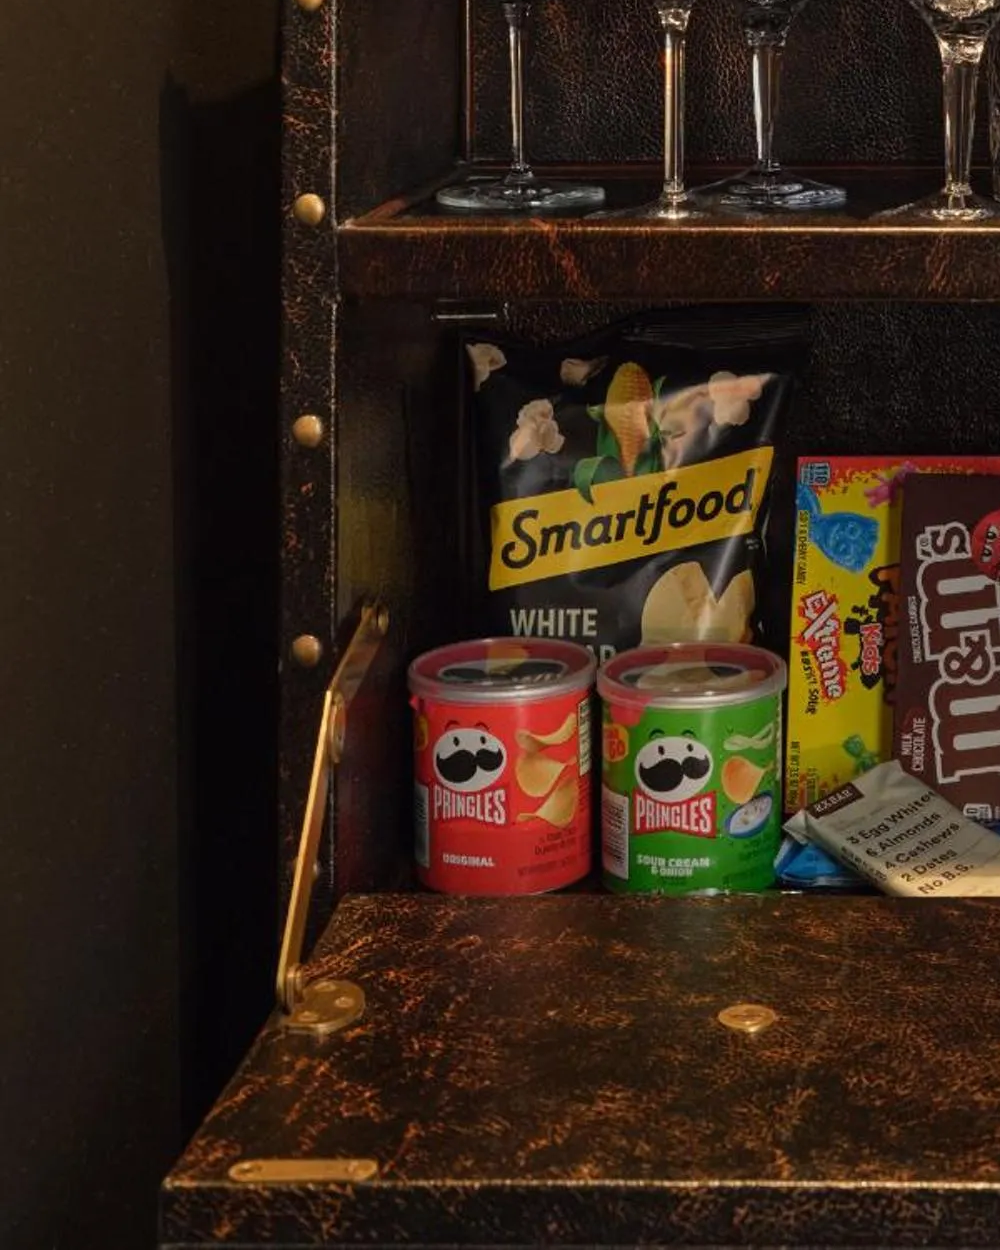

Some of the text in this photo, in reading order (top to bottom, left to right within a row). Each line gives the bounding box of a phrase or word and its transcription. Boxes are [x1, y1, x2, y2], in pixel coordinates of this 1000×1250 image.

[501, 468, 757, 570] Smartfood
[510, 608, 598, 637] WHITE
[805, 688, 819, 716] SOUR
[902, 732, 913, 756] MILK
[912, 717, 926, 772] CHOCOLATE
[433, 784, 506, 825] PRINGLES
[635, 794, 712, 834] PRINGLES
[858, 823, 890, 839] Egg
[865, 847, 878, 858] 6
[878, 812, 941, 851] Almonds
[885, 860, 897, 870] 4
[896, 822, 960, 863] Cashews
[442, 853, 495, 867] ORIGINAL
[636, 854, 711, 869] SOUR CREAM
[660, 867, 693, 877] ONION
[901, 849, 958, 883] 2 Dates
[917, 864, 974, 894] No B.S.
